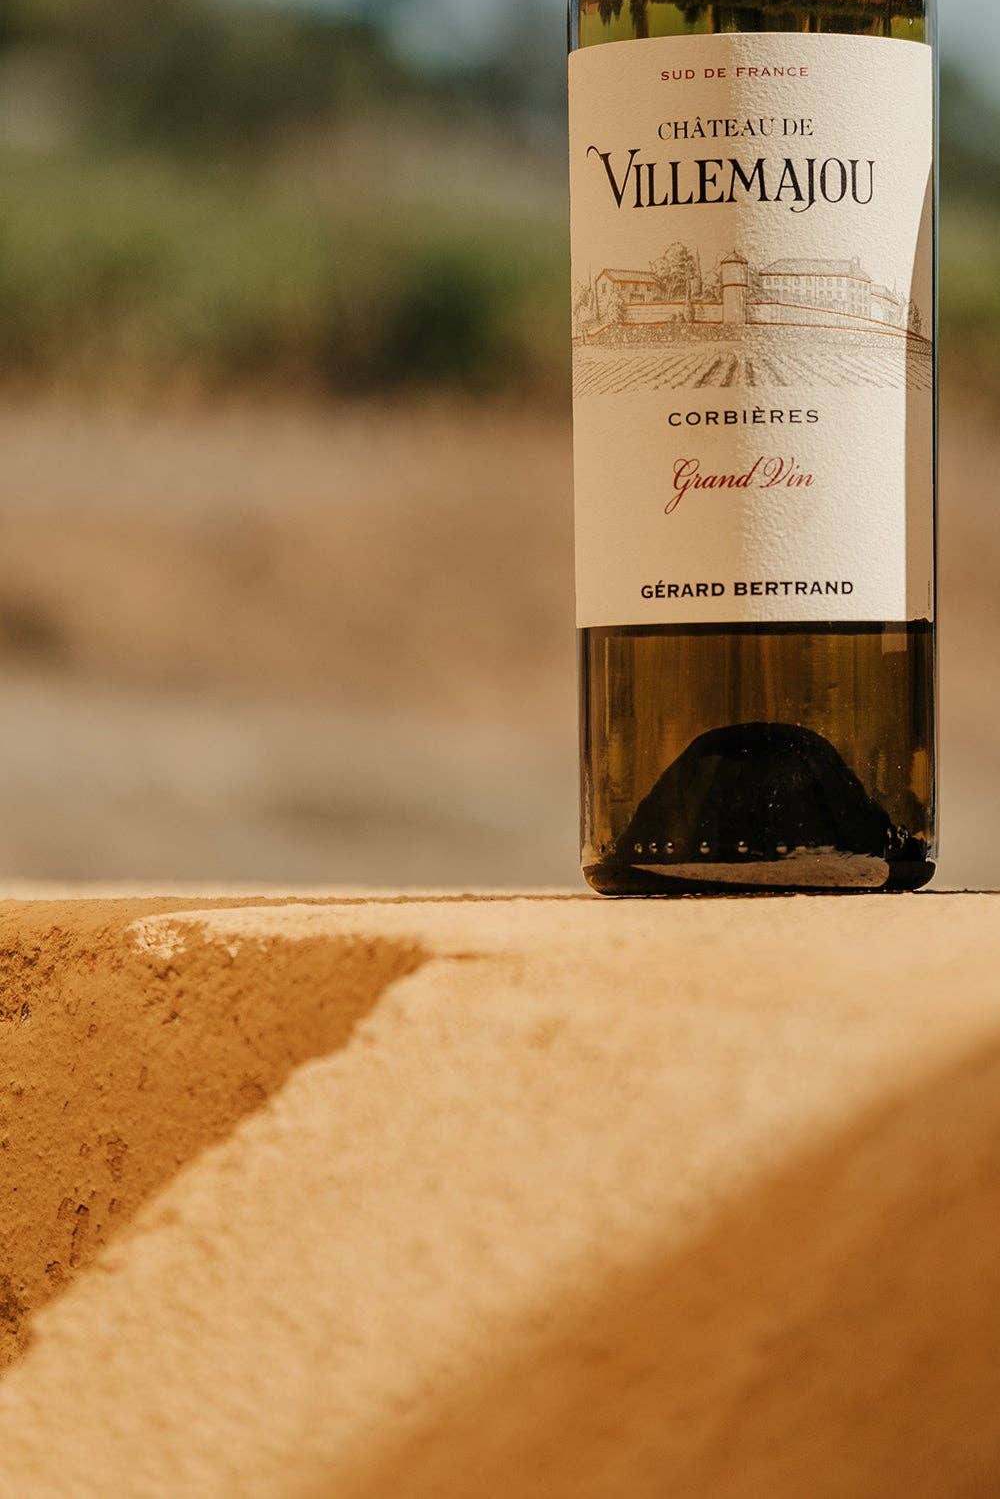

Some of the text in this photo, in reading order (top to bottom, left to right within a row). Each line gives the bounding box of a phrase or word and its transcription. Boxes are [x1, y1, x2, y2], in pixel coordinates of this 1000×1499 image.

[661, 66, 810, 81] SUD DE FRANCE
[657, 116, 815, 141] CHÂTEAU DE
[586, 145, 876, 213] VILLEMAJOU
[668, 406, 820, 427] CORBIÈRES
[664, 456, 815, 515] Grand Vin
[640, 580, 854, 599] GÉRARD BERTRAND
